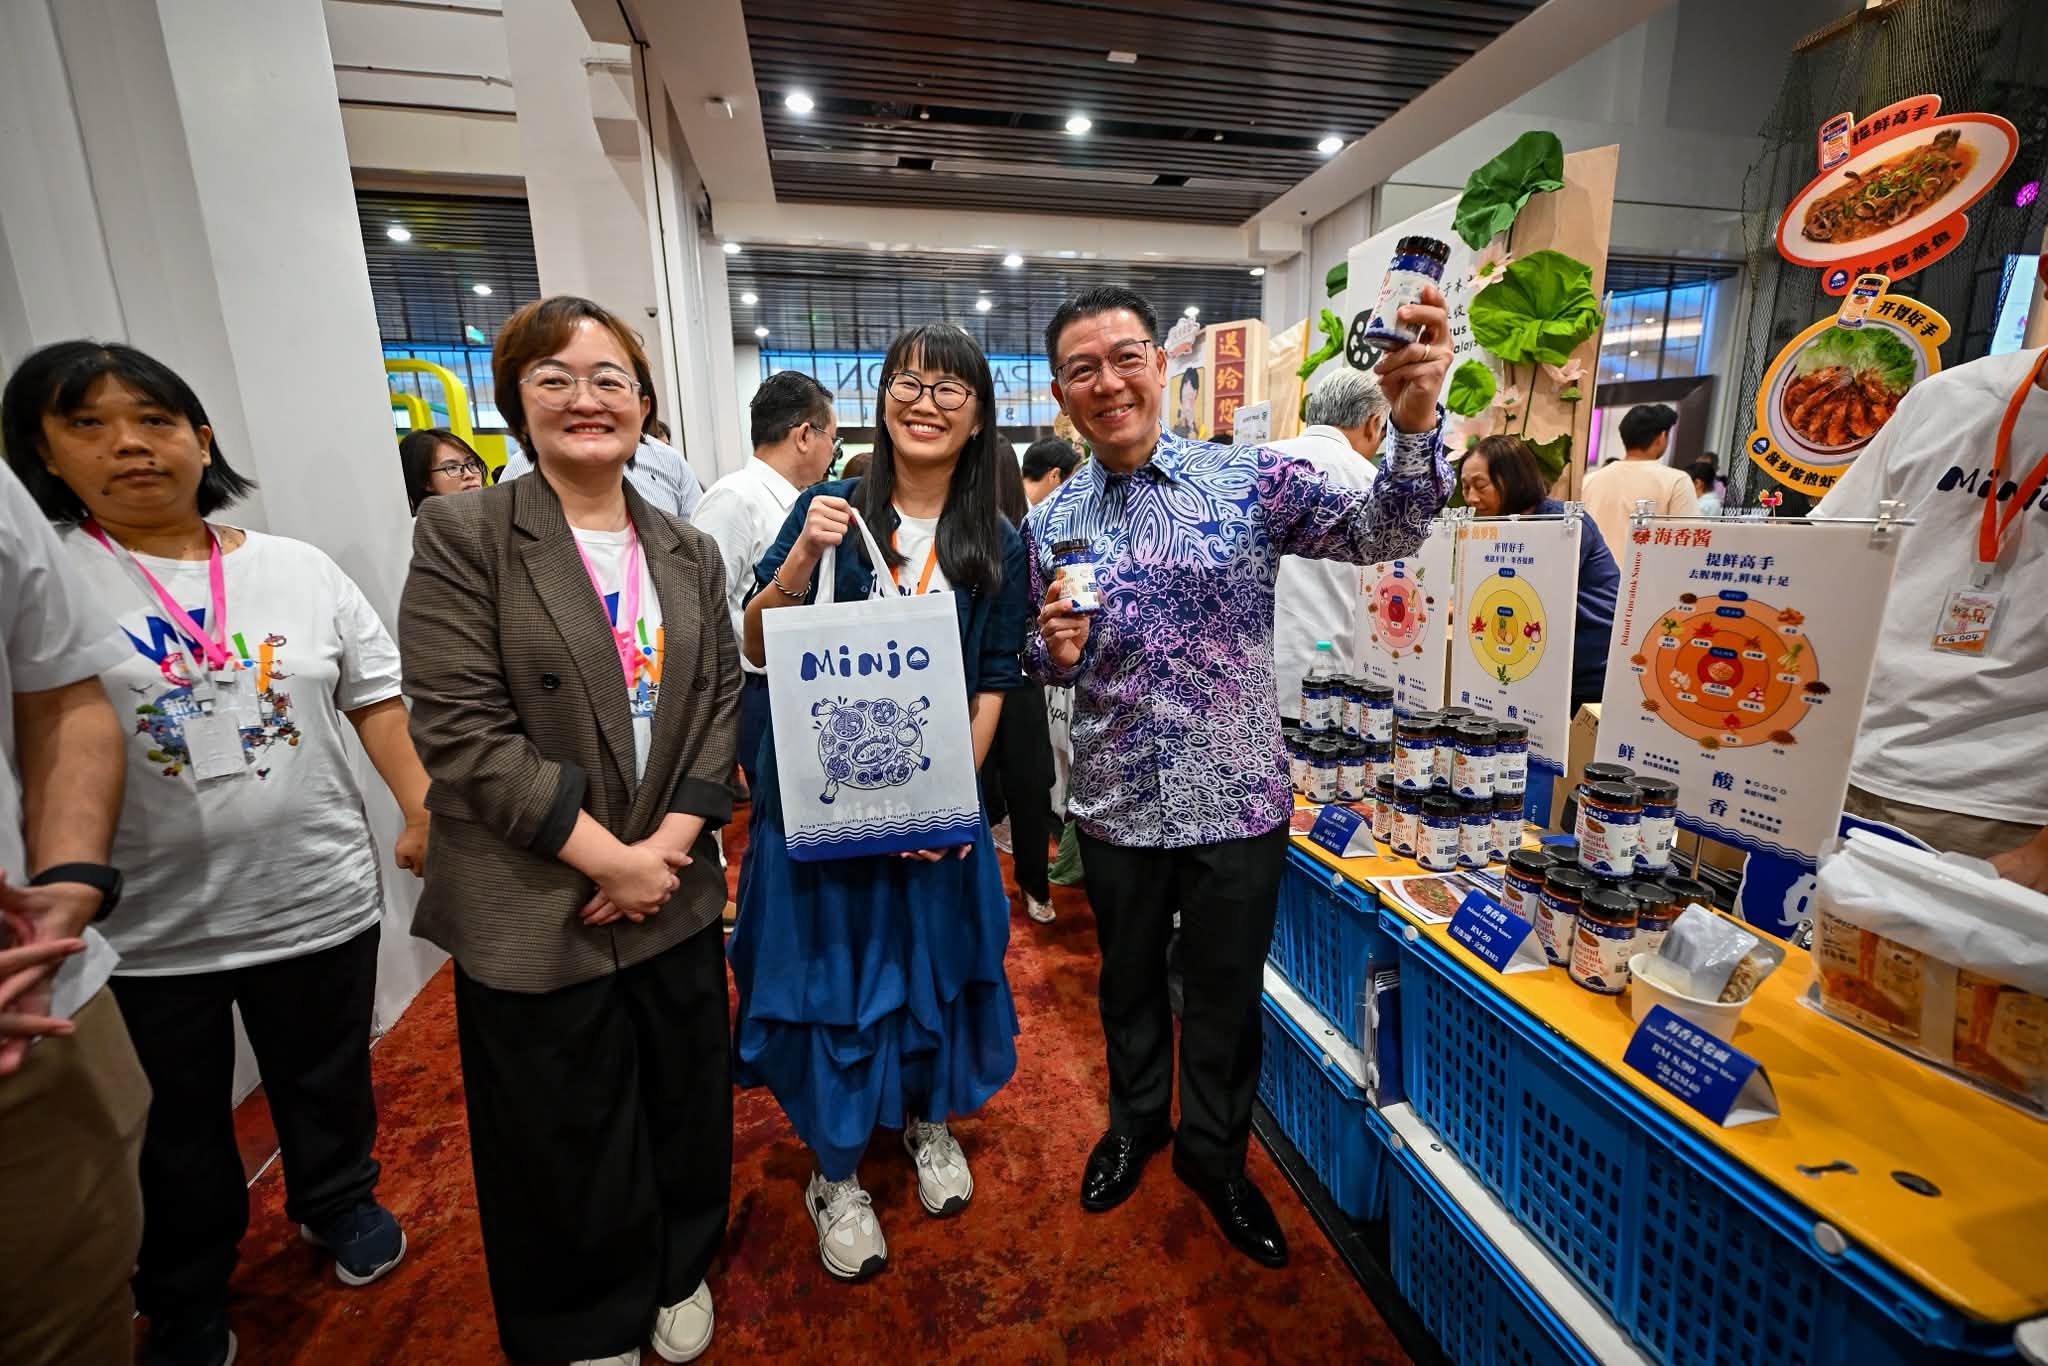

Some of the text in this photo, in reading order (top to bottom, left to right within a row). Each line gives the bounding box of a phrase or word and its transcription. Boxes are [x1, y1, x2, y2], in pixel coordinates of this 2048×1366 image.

[1876, 300, 1939, 337] 开胃好手
[1654, 527, 1713, 548] 海香酱
[1705, 552, 1776, 571] 提鲜高手
[1621, 620, 1632, 646] Island
[1632, 551, 1642, 577] Sauce
[1618, 743, 1635, 761] 鲜
[1711, 770, 1735, 792] 酸
[1708, 798, 1728, 818] 香
[1651, 1042, 1671, 1059] RM
